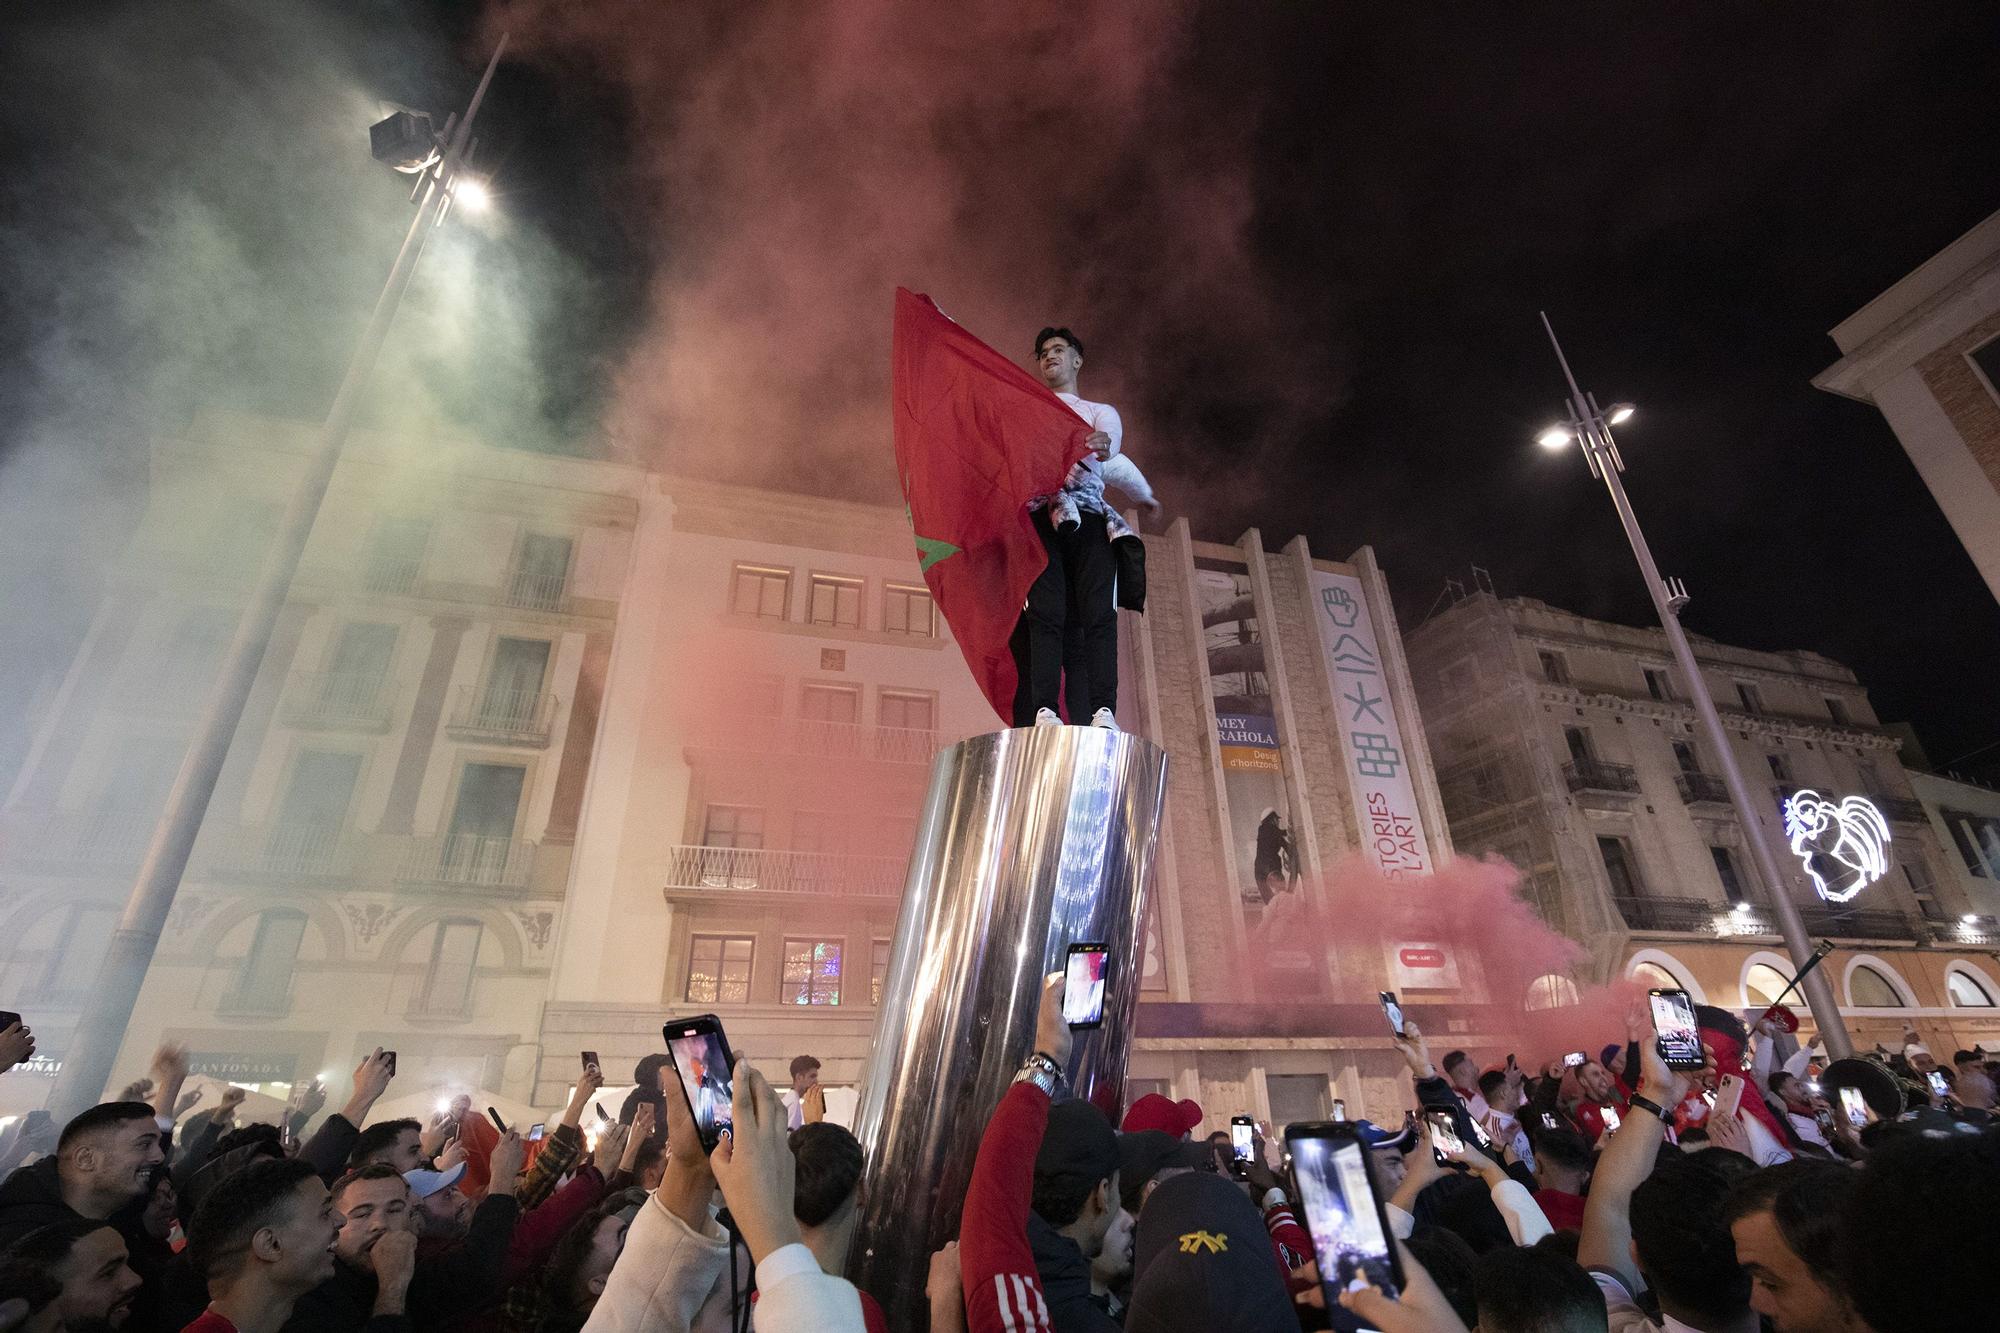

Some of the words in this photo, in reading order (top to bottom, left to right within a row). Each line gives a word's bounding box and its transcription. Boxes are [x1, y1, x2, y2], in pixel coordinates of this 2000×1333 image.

[1216, 718, 1247, 729] MEY
[1217, 730, 1275, 745] RAHOLA
[1230, 759, 1279, 770] d'horitzons
[1391, 811, 1424, 871] L'ART
[188, 1063, 283, 1073] CANTONADA
